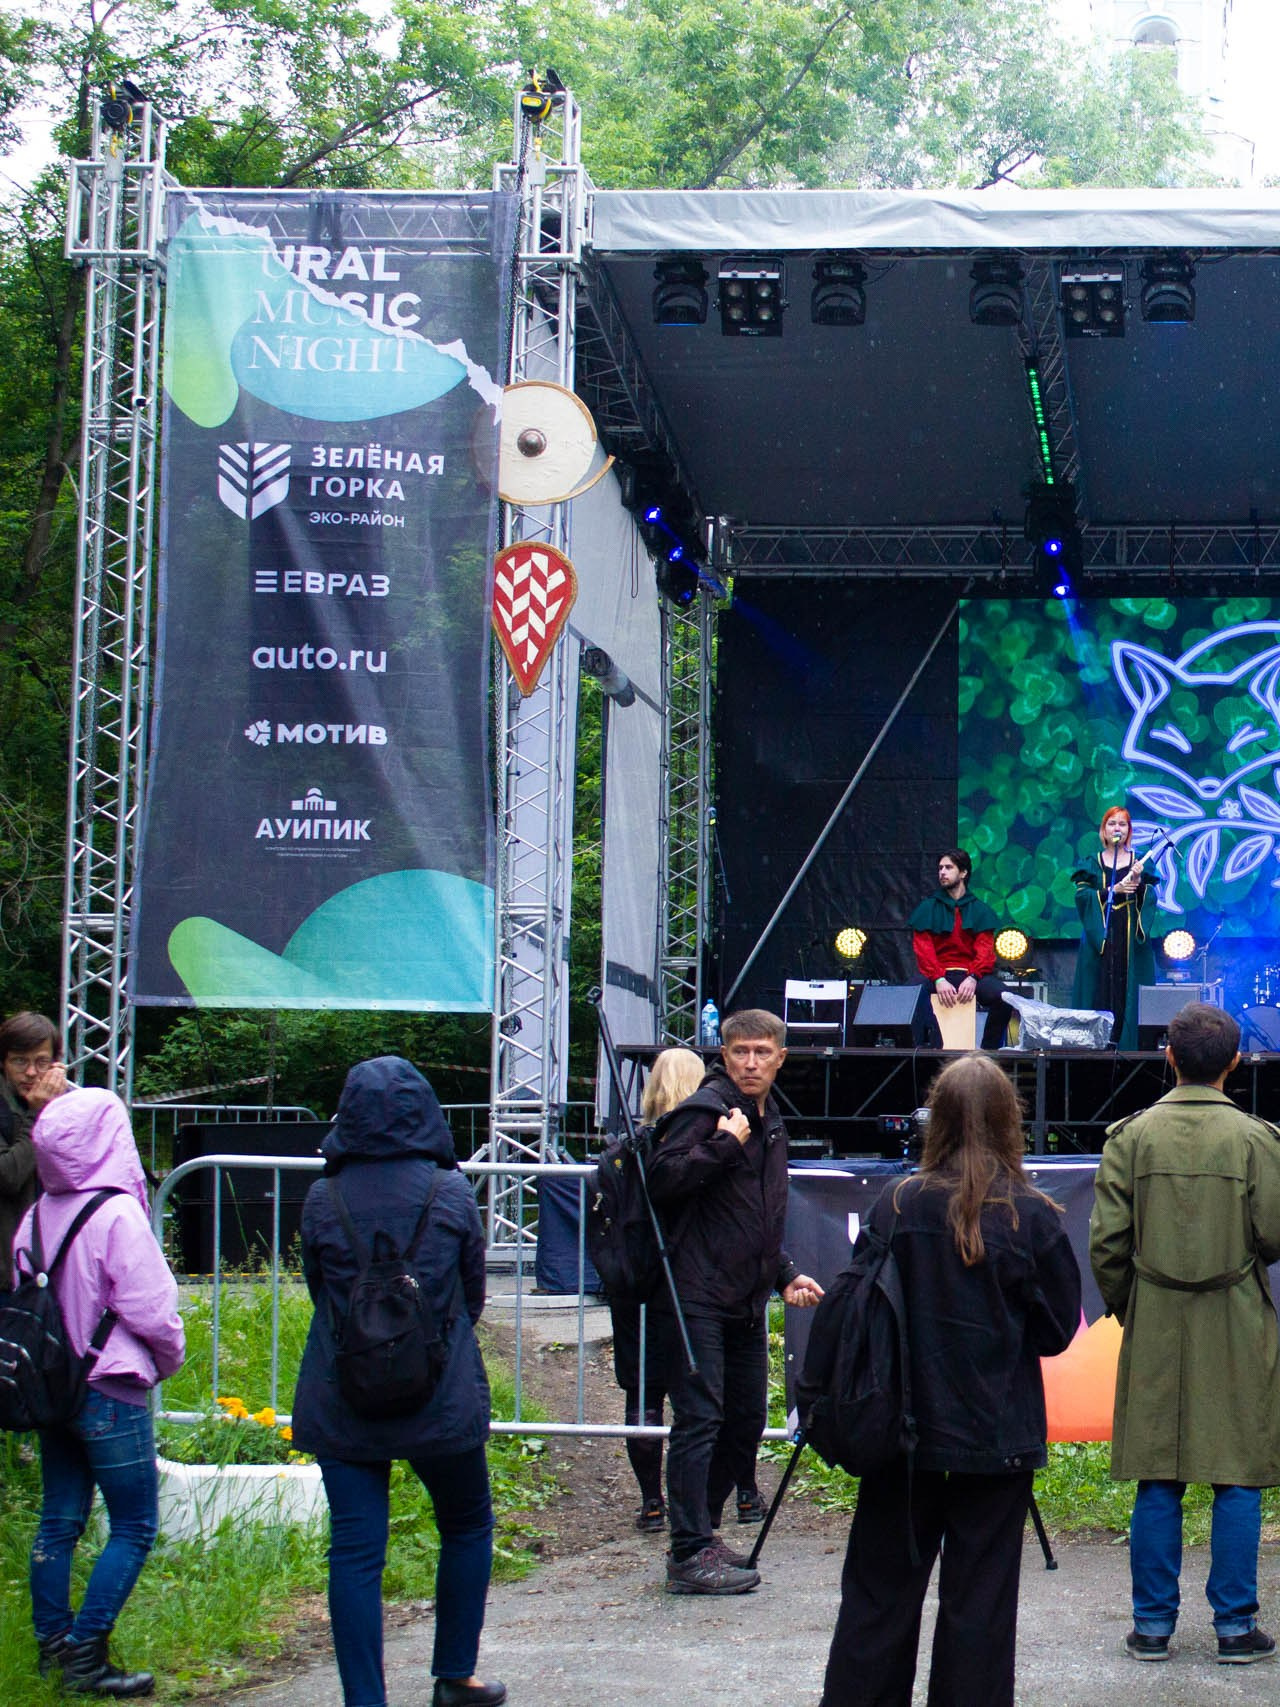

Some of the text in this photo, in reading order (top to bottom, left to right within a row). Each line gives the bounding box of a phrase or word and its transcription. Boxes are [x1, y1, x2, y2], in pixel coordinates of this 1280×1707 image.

[260, 244, 400, 281] URAL
[251, 290, 422, 327] MUSIC
[247, 334, 417, 373] NIGHT
[311, 443, 445, 475] ЗЕЛЁНАЯ
[310, 477, 405, 501] ГОРКА
[309, 510, 405, 528] ЭКО-РАЙОН
[284, 570, 391, 597] ЕВРАЗ
[252, 642, 387, 673] auto.ru
[277, 723, 388, 745] МОТИВ
[255, 818, 371, 840] АУИПИК
